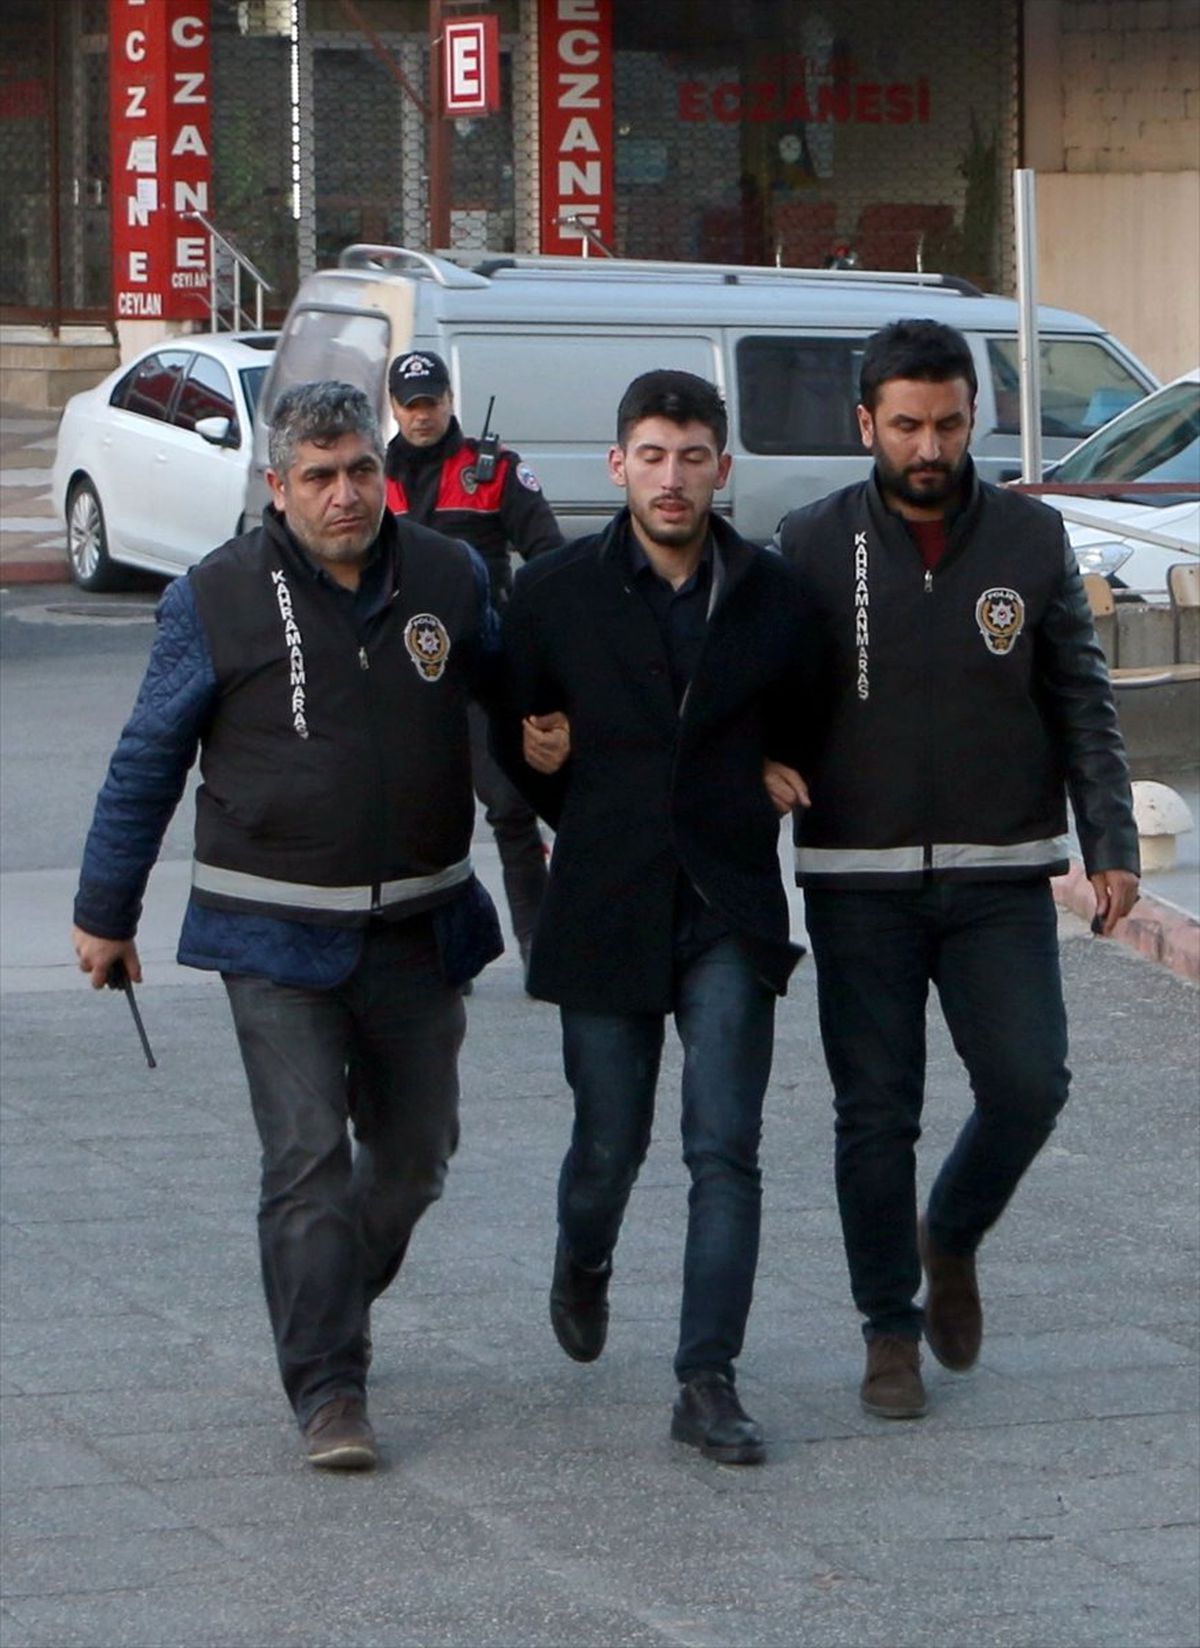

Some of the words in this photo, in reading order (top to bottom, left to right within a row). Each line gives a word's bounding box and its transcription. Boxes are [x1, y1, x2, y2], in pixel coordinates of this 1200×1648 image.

[453, 36, 479, 95] E
[558, 0, 601, 239] ECZANE
[118, 291, 162, 316] CEYLAN
